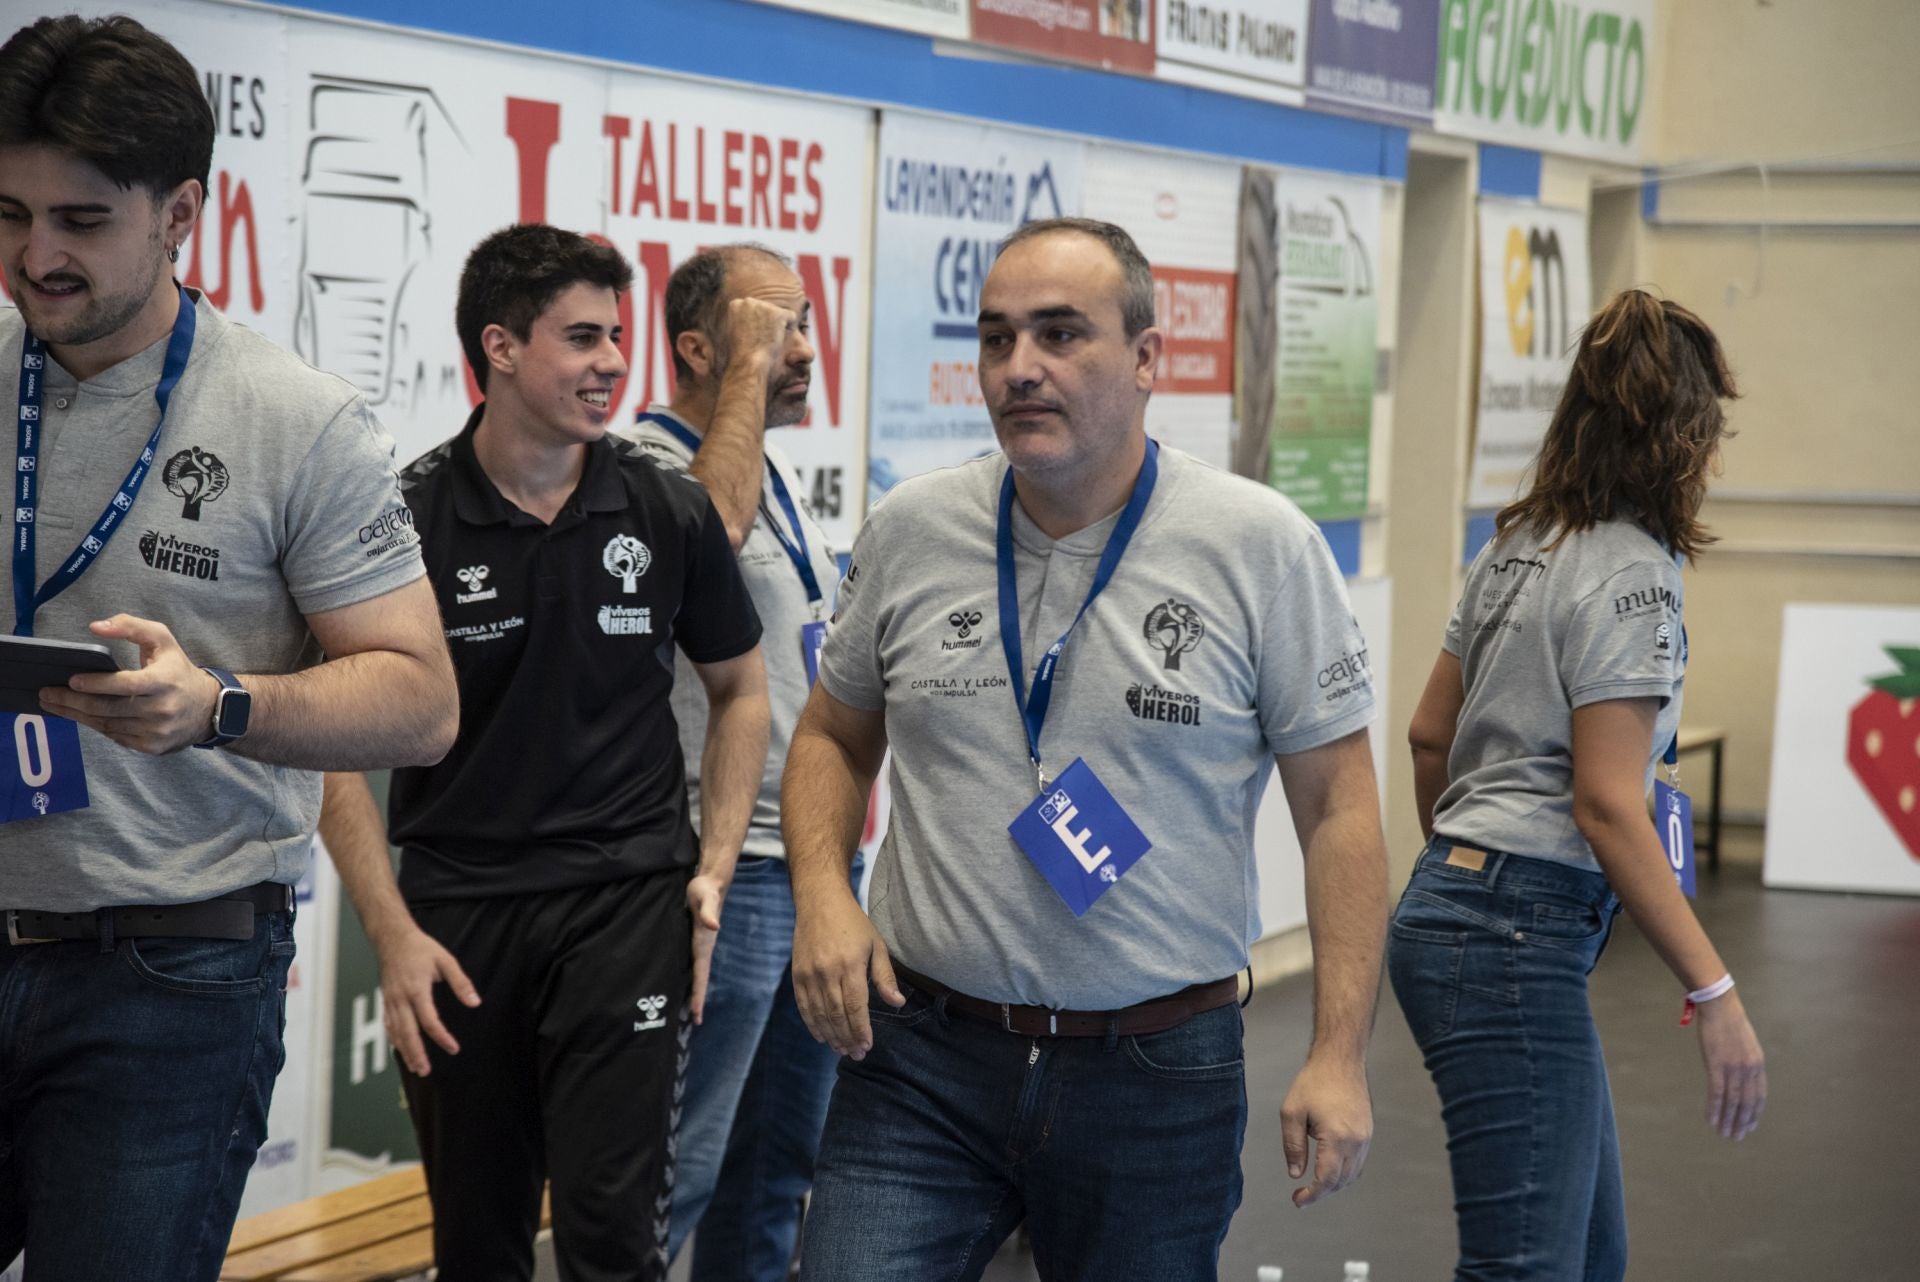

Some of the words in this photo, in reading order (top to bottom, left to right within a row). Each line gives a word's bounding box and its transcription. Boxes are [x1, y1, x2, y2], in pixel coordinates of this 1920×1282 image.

[603, 115, 823, 233] TALLERES
[886, 154, 1015, 224] LAVANDERÍA
[159, 533, 220, 559] VIVEROS
[155, 548, 219, 581] HEROL
[456, 587, 498, 604] hummel
[610, 605, 651, 617] VIVEROS
[489, 623, 498, 633] Y
[609, 616, 653, 634] HEROL
[942, 636, 982, 650] hummel
[911, 679, 957, 690] CASTILLA
[961, 678, 972, 689] Y
[975, 676, 1008, 688] LEÓN
[1144, 684, 1200, 705] VIVEROS
[1142, 699, 1200, 726] HEROL
[1051, 804, 1112, 875] E
